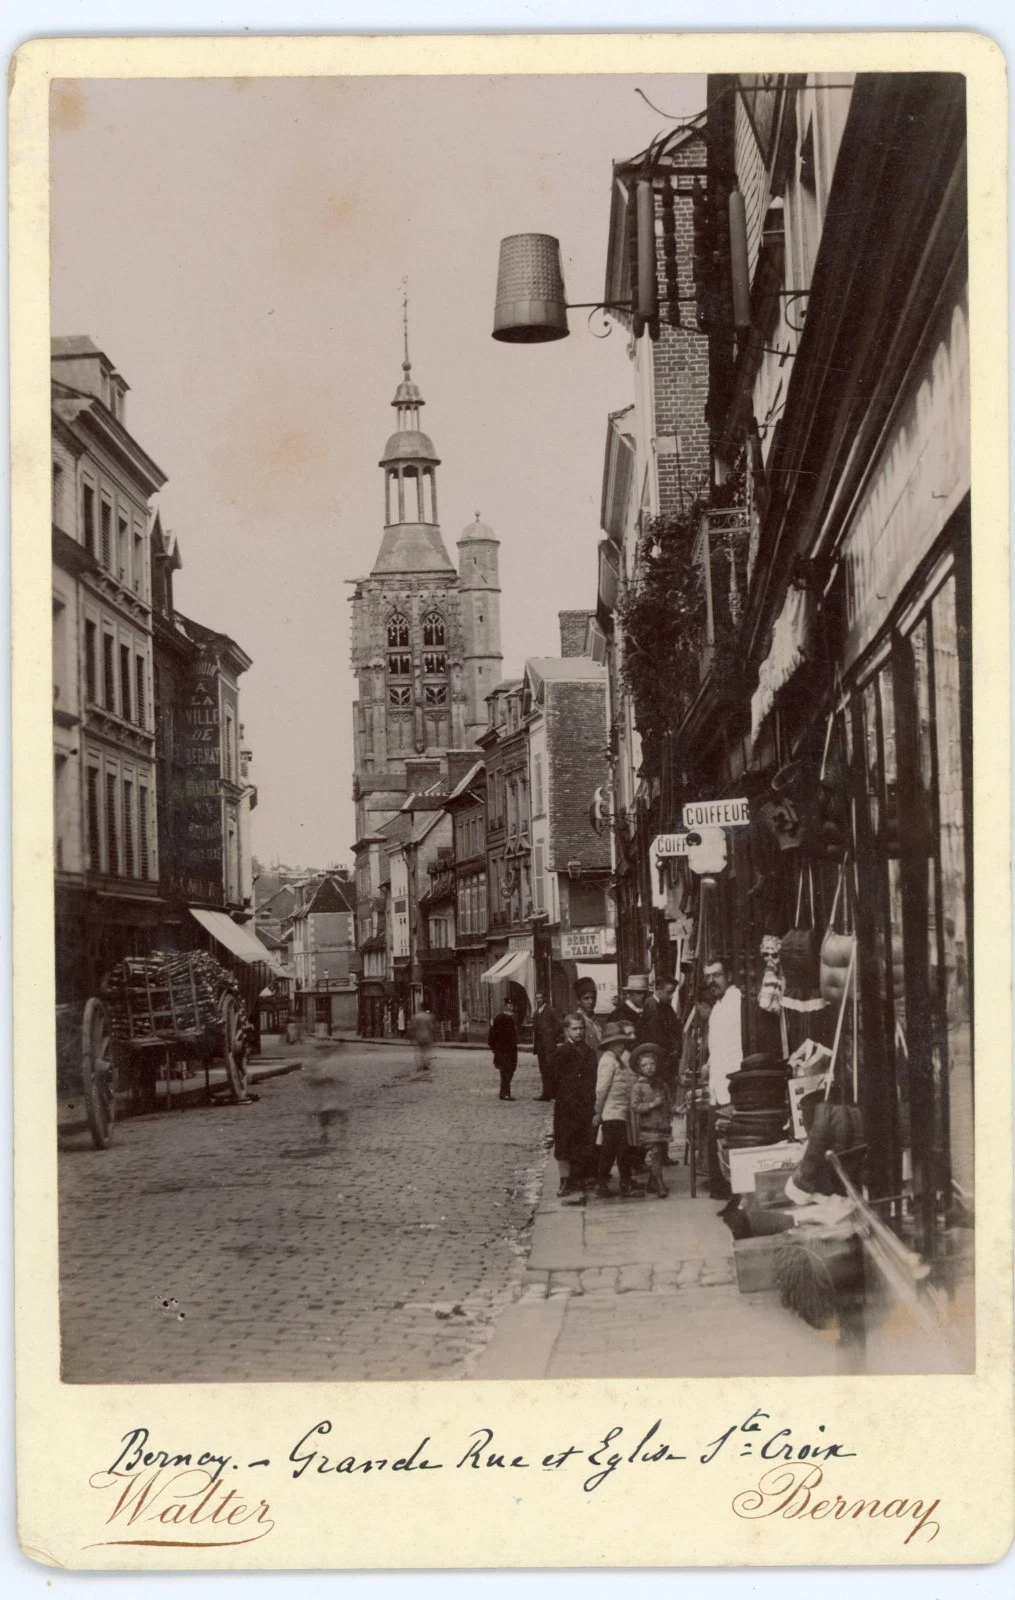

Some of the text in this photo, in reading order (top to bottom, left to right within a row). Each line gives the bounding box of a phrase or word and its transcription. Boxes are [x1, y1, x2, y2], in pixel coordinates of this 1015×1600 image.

[196, 682, 208, 692] A
[191, 696, 214, 706] LA
[186, 708, 219, 725] VILLE
[191, 728, 214, 741] DE
[686, 802, 749, 826] COIFFEUR
[571, 945, 599, 956] TABAC
[289, 1420, 443, 1479] Grande
[457, 1428, 529, 1469] Rue
[542, 1446, 583, 1468] et
[583, 1418, 687, 1493] Eglise
[761, 1425, 857, 1461] Croix
[87, 1462, 941, 1544] Walter Bernay
